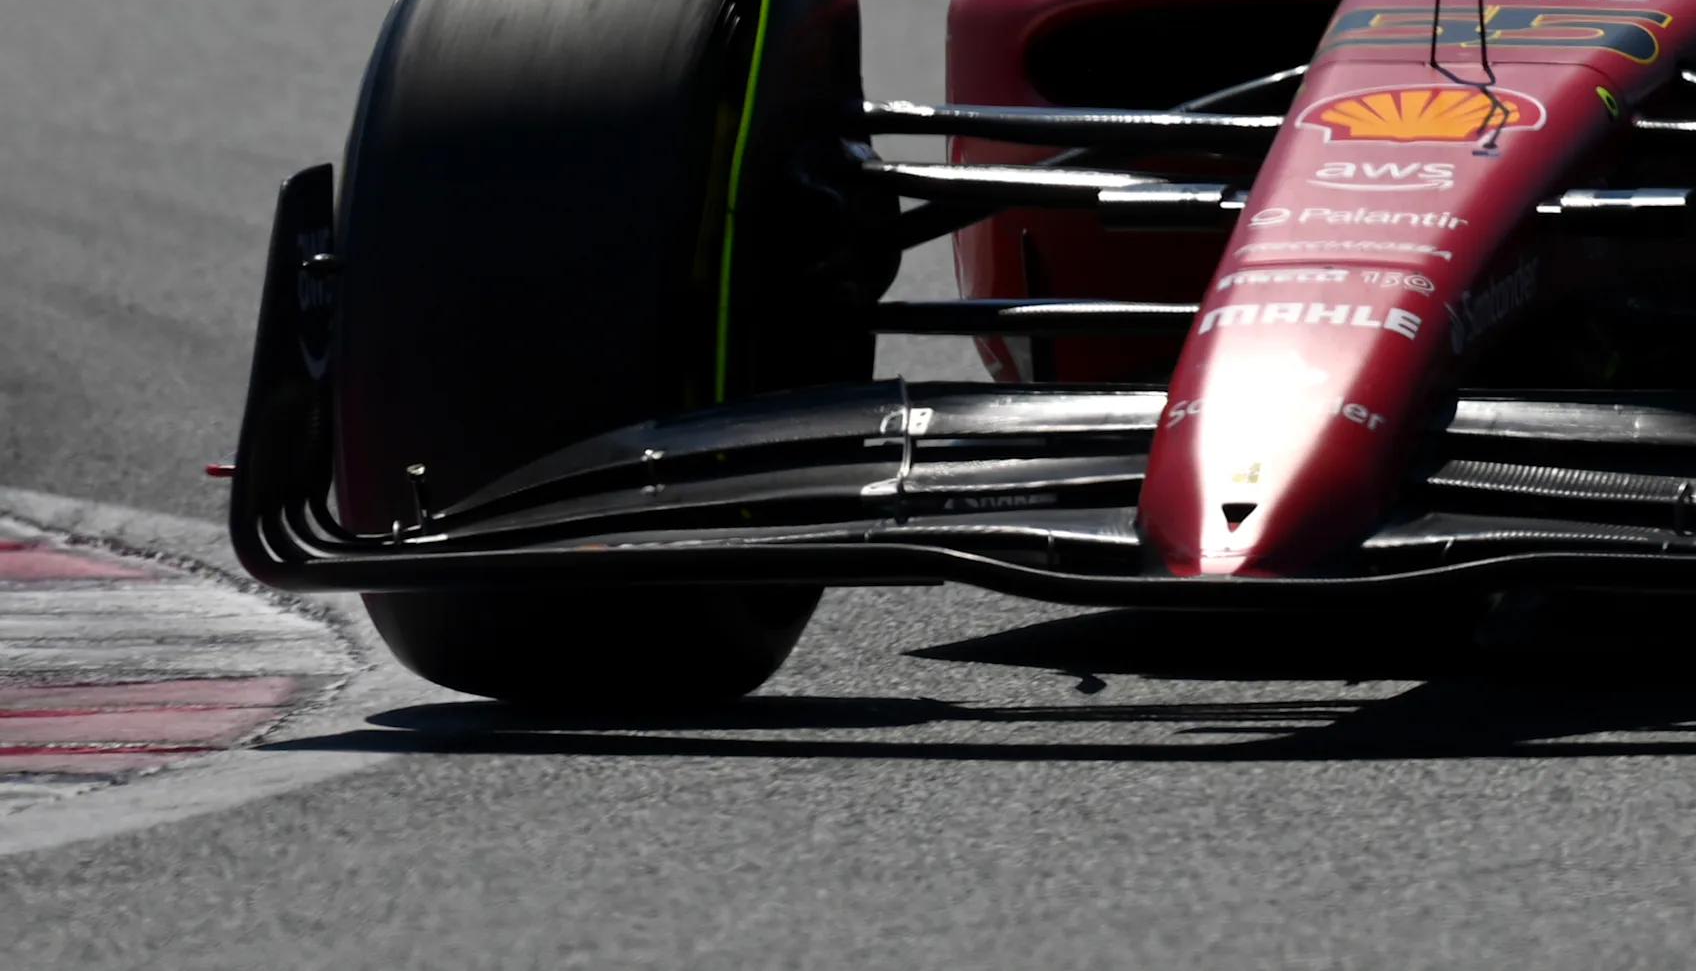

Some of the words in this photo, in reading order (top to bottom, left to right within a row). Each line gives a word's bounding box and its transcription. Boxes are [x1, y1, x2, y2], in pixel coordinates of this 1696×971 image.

[1316, 5, 1674, 65] 55
[1315, 161, 1457, 180] aws
[1298, 207, 1469, 229] Palantir
[1197, 302, 1423, 341] MAHLE
